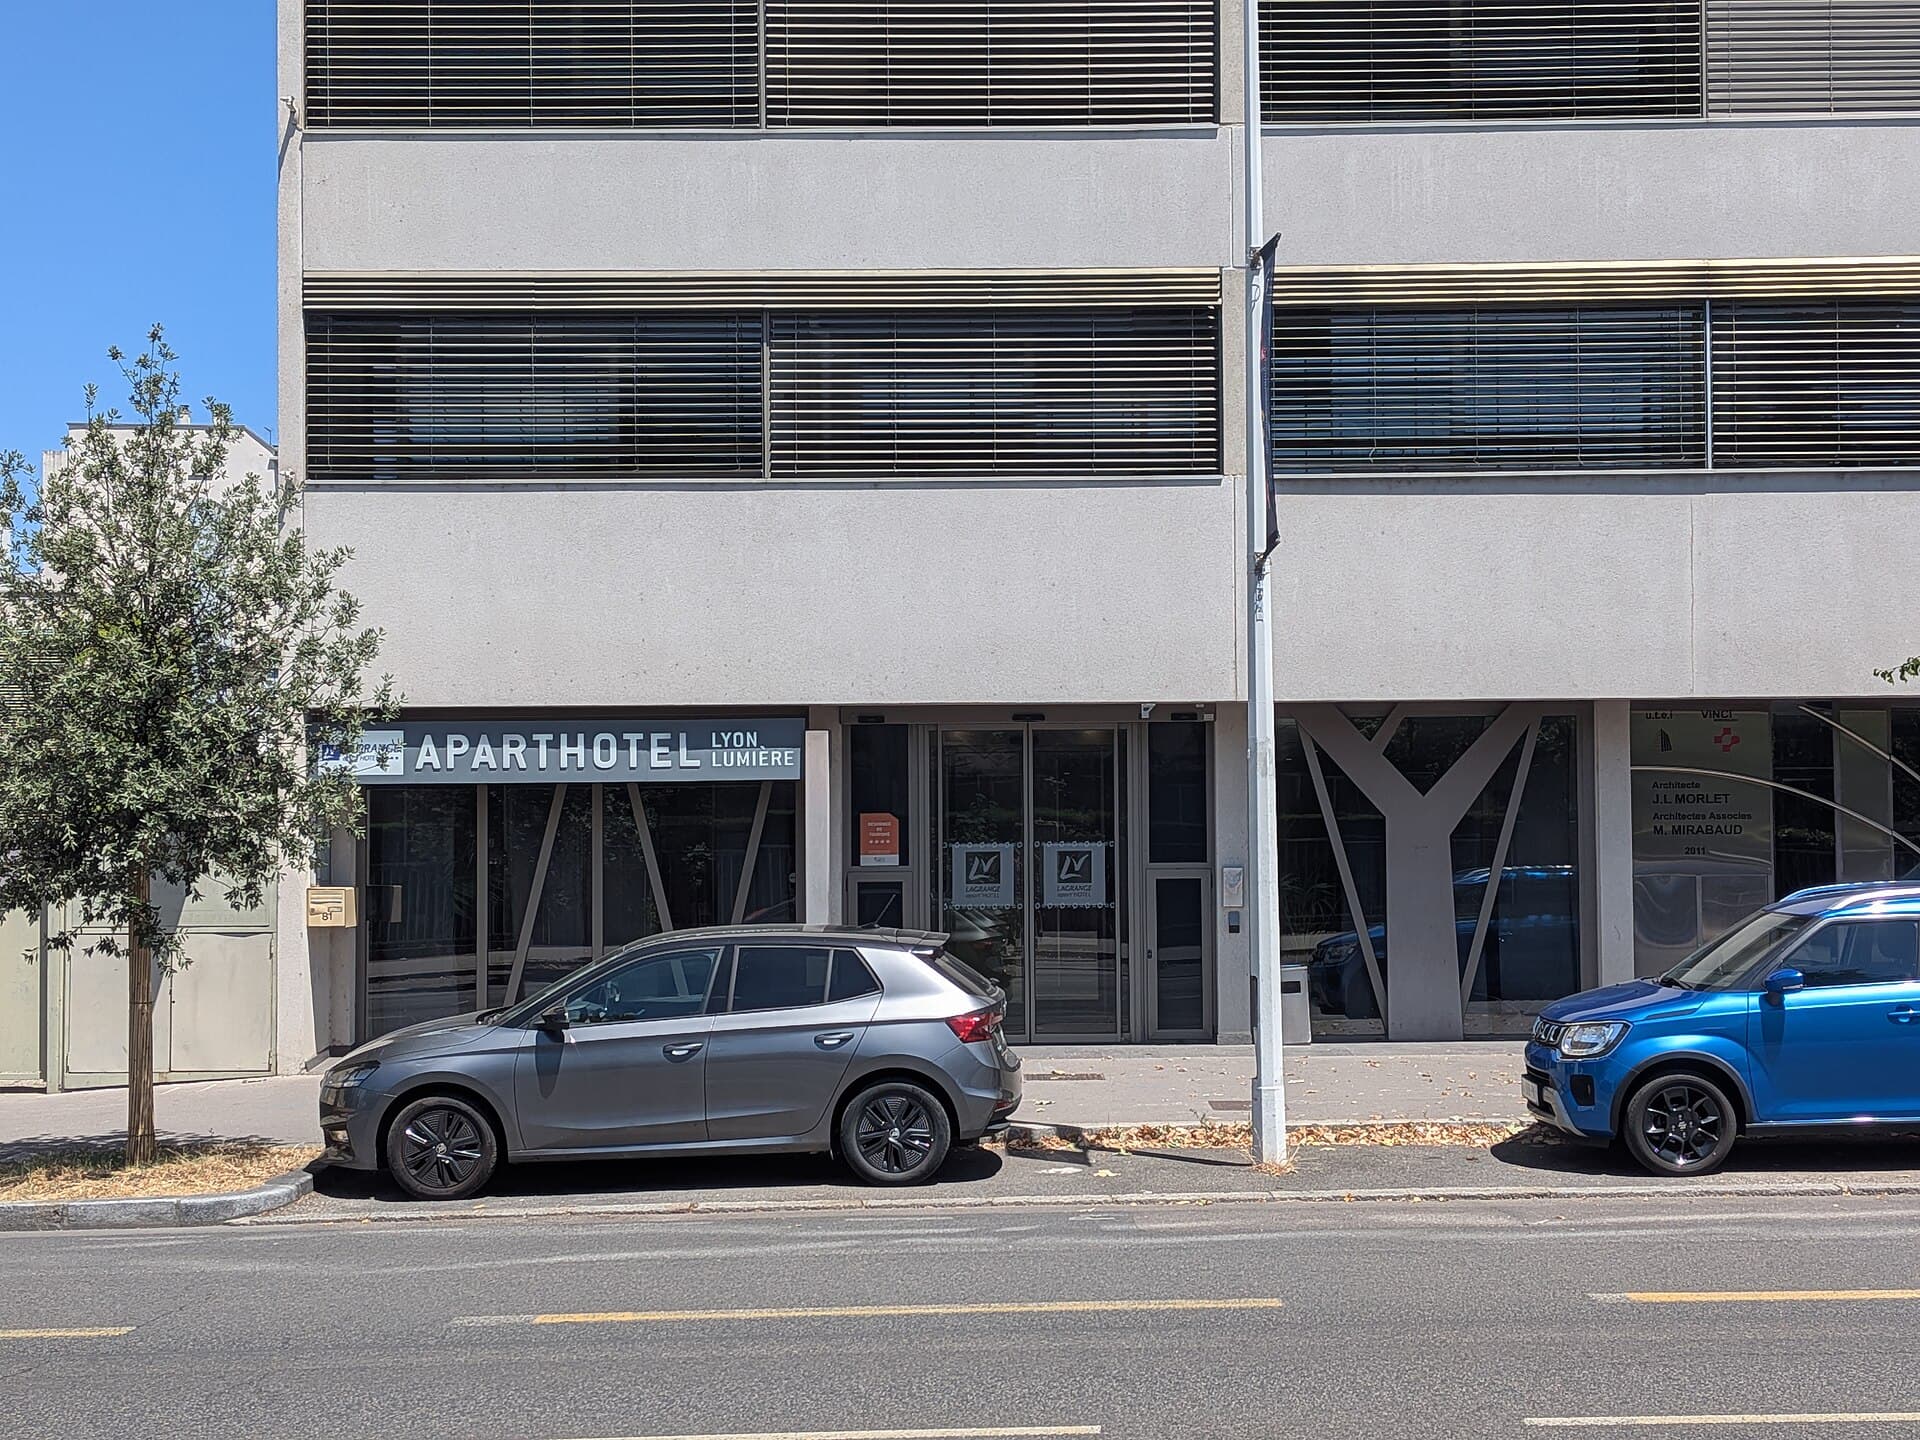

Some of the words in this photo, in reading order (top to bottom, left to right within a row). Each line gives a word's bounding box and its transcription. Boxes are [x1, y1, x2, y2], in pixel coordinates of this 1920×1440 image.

[711, 731, 760, 748] LYON
[415, 732, 702, 770] APARTHOTEL
[711, 746, 796, 767] LUMIÈRE
[1674, 793, 1730, 804] MORLET
[1653, 825, 1668, 836] M.
[1671, 825, 1743, 836] MIRABAUD
